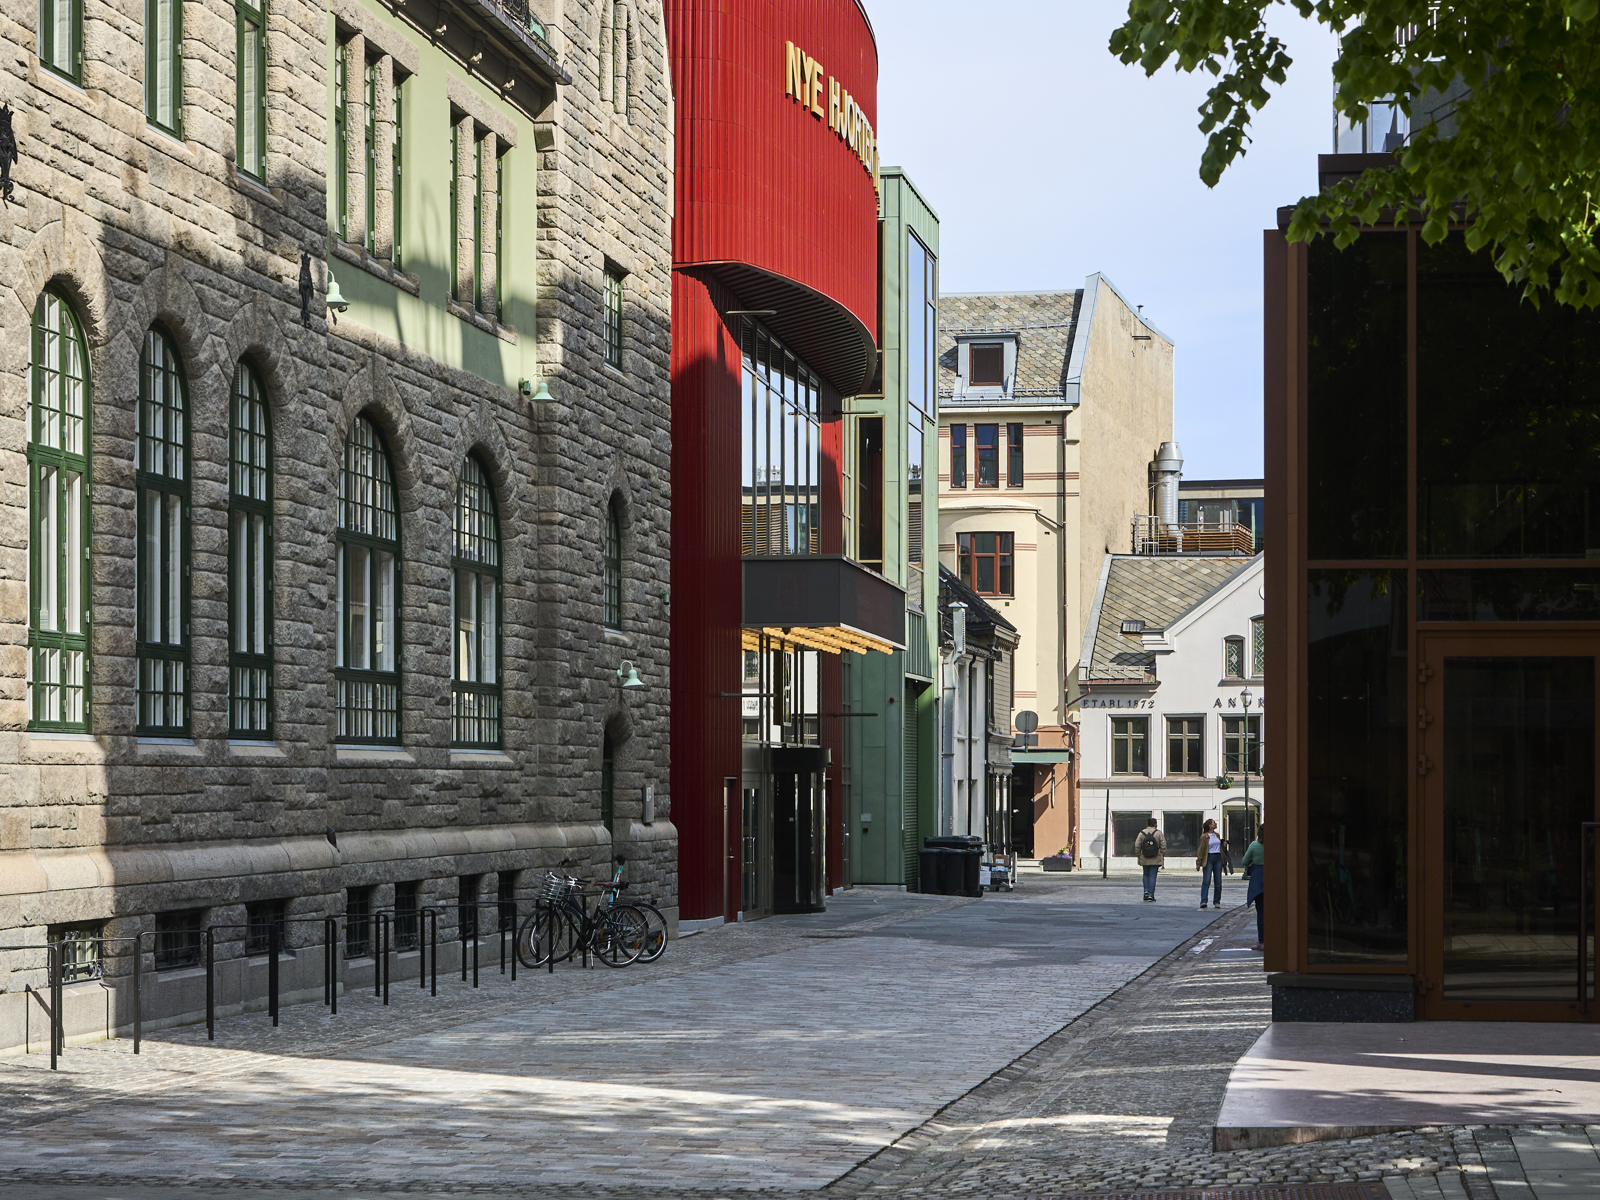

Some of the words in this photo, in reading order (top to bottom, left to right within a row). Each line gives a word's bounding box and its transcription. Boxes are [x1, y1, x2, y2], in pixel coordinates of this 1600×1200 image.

[785, 41, 825, 119] NYE
[1083, 699, 1124, 709] ETABL
[1127, 699, 1155, 709] 1872
